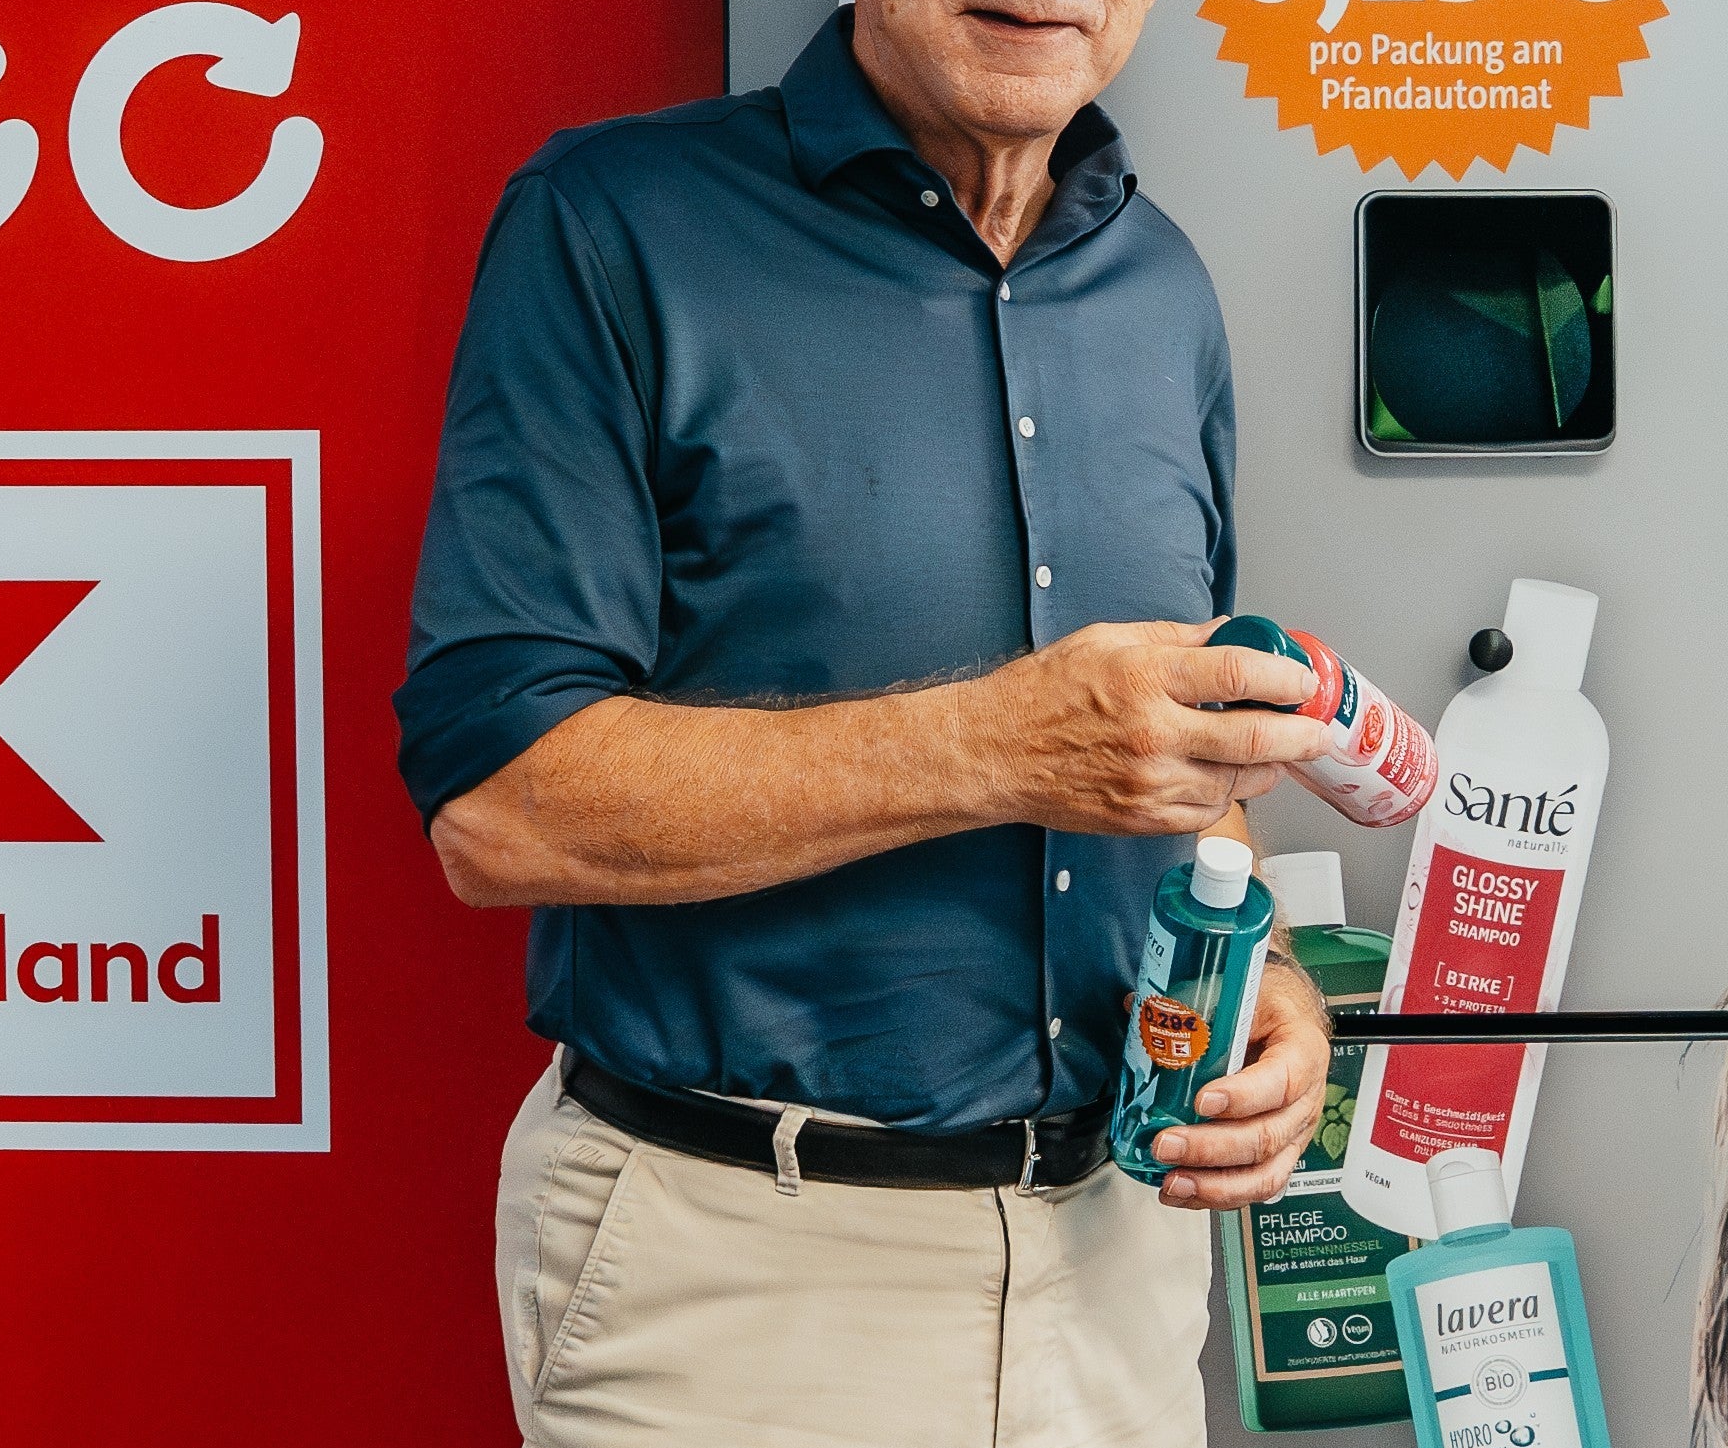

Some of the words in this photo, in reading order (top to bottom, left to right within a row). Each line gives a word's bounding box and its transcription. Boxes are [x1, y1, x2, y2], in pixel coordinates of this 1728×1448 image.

[1309, 38, 1364, 77] pro
[1371, 30, 1506, 74] Packung
[1513, 41, 1563, 66] am
[1320, 75, 1554, 112] Pfandautomat
[1445, 772, 1578, 837] Santé
[1452, 865, 1539, 901] GLOSSY
[1454, 892, 1526, 926] SHINE
[1449, 920, 1521, 947] SHAMPOO
[1459, 999, 1506, 1014] PROTEIN
[1364, 1168, 1392, 1190] VEGAN
[1259, 1210, 1324, 1230] PFLEGE
[1260, 1225, 1347, 1246] SHAMPOO
[1345, 1254, 1369, 1265] Haar
[1296, 1291, 1320, 1302] ALLE
[1321, 1285, 1377, 1300] HAARTYPEN
[1437, 1293, 1539, 1337] lavera
[1441, 1326, 1545, 1355] NATURKOSMETIK
[1484, 1372, 1515, 1392] BIO
